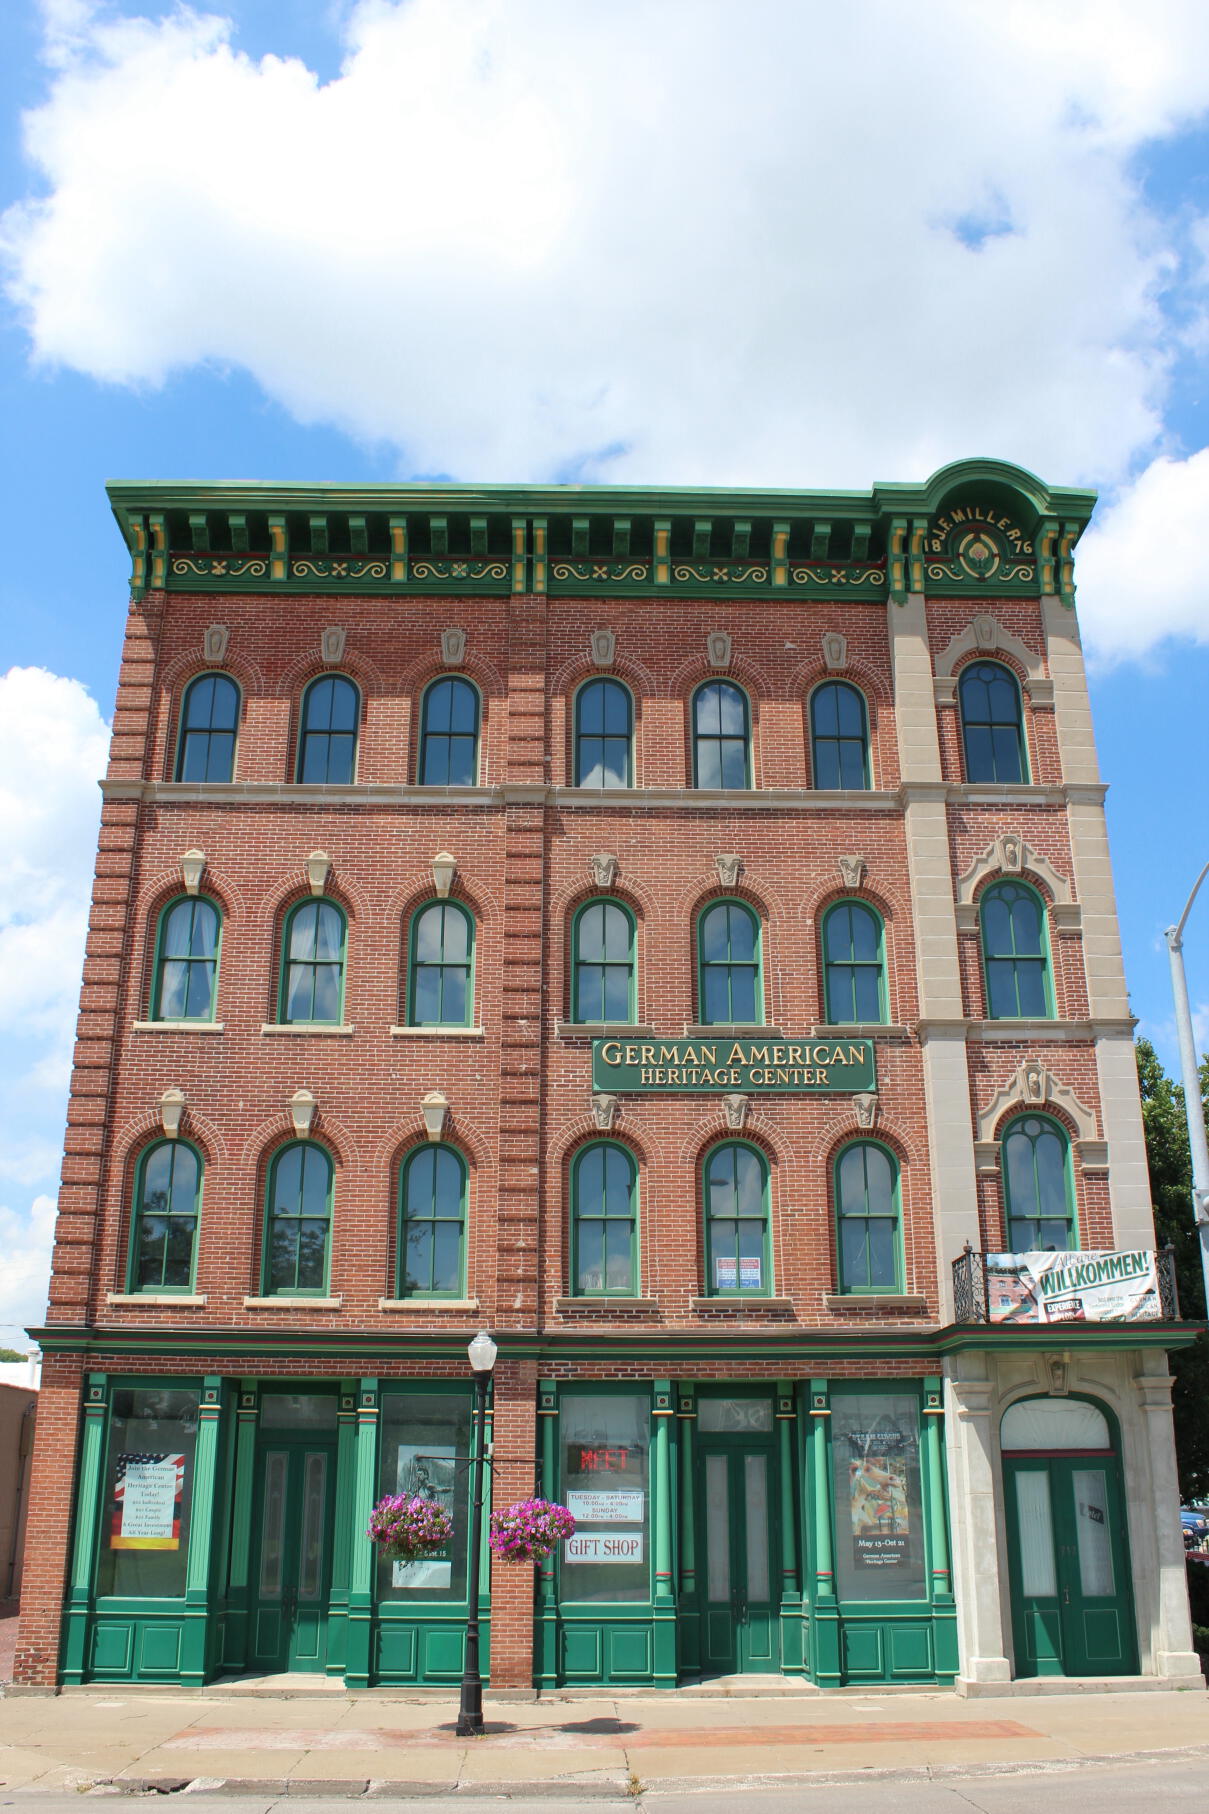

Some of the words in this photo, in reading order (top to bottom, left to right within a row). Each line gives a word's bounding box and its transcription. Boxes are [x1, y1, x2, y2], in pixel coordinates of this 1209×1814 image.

[950, 507, 1021, 540] MILLER
[1013, 541, 1033, 554] 76
[601, 1041, 718, 1066] GERMAN
[725, 1042, 866, 1066] AMERICAN
[640, 1068, 742, 1085] HERITAGE
[749, 1068, 831, 1085] CENTER
[1040, 1251, 1150, 1297] WILLKOMMEN!
[581, 1449, 629, 1471] MEET
[569, 1539, 600, 1556] GIFT
[603, 1539, 640, 1556] SHOP
[858, 1539, 873, 1548] May
